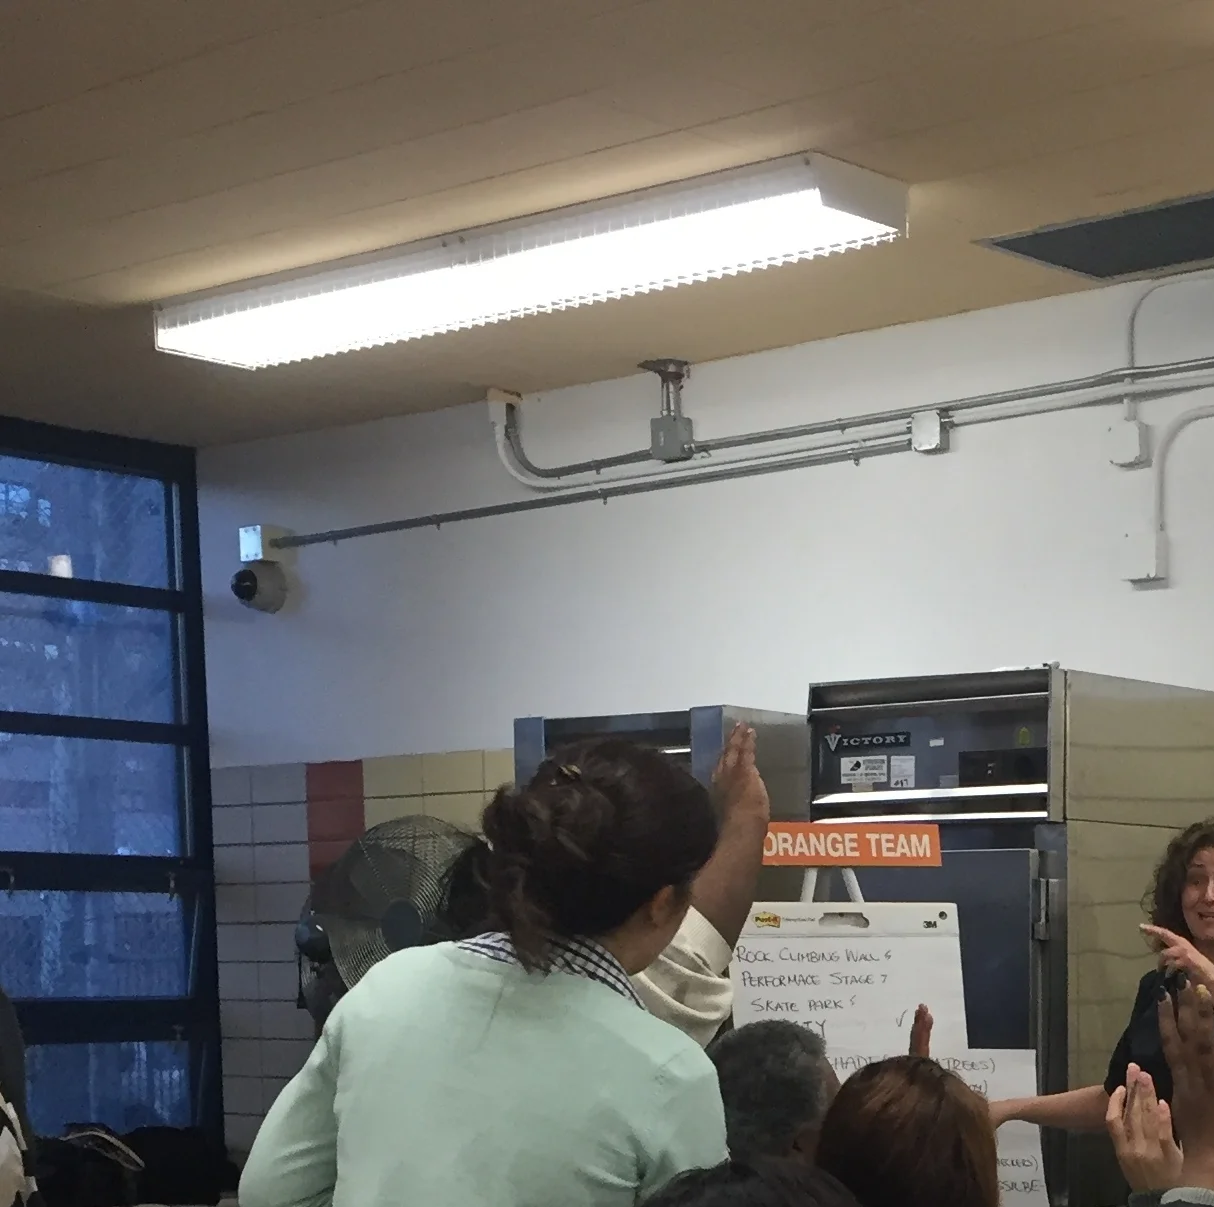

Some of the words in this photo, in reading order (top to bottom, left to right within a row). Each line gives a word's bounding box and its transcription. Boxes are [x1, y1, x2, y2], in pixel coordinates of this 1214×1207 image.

[824, 733, 907, 752] VICTORY
[763, 831, 860, 858] ORANGE
[866, 833, 931, 858] TEAM
[923, 920, 938, 929] 3M
[779, 947, 840, 963] CLIMBING
[845, 949, 880, 963] WALL
[829, 972, 875, 986] STAGE
[808, 998, 844, 1011] PARK
